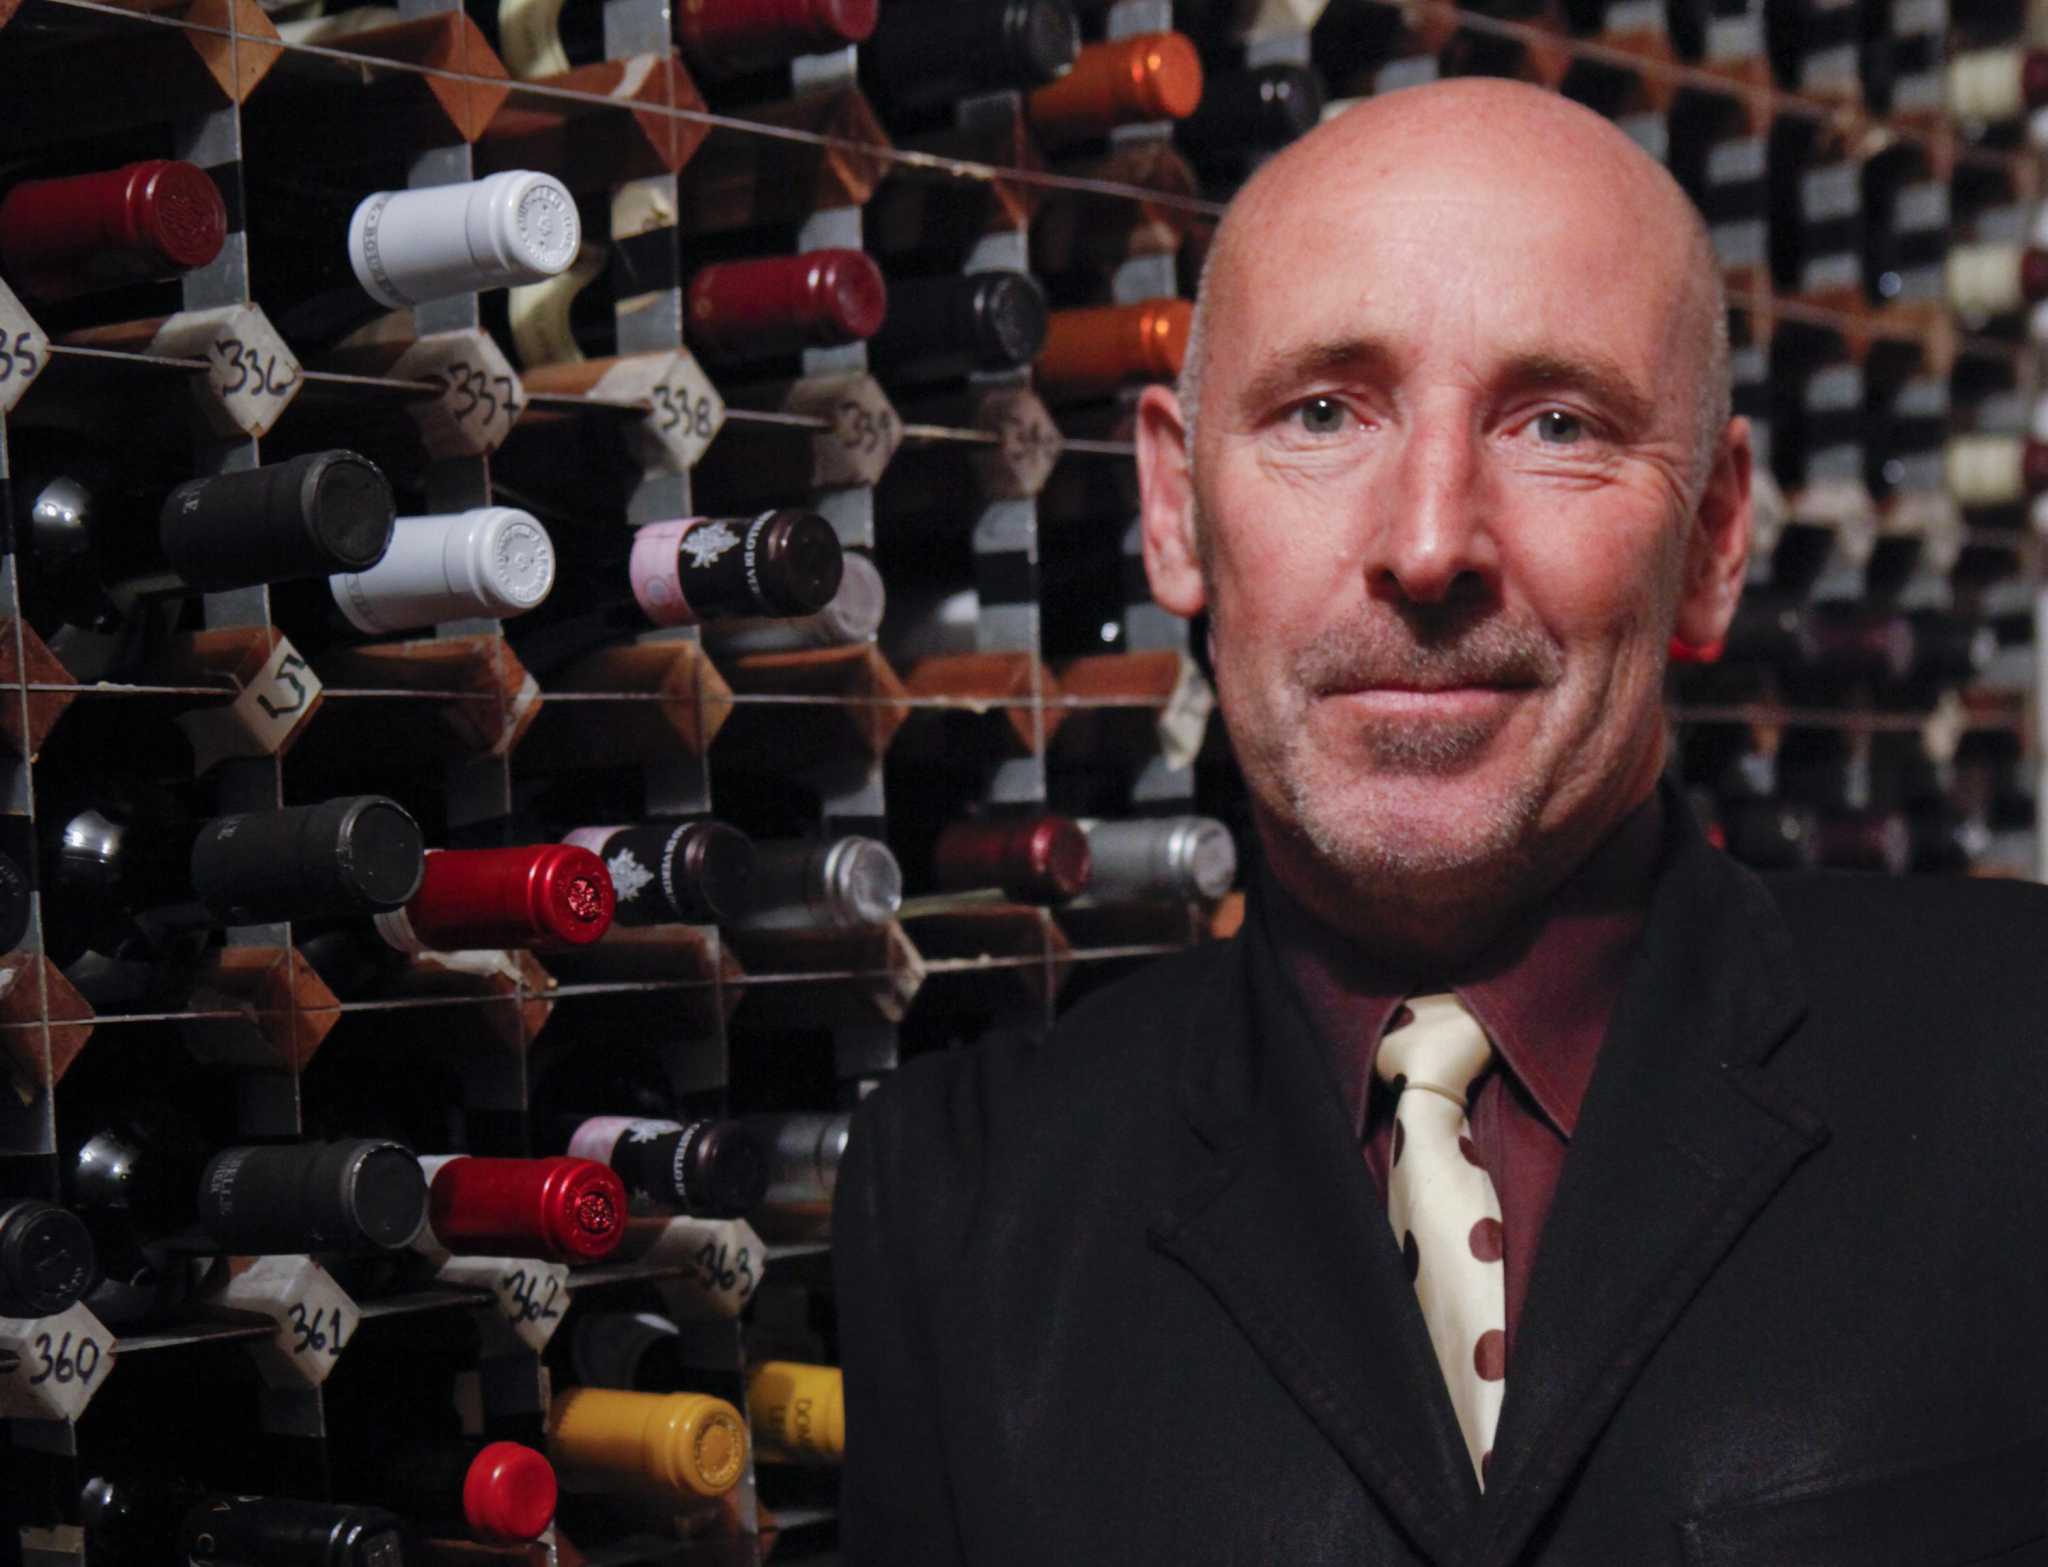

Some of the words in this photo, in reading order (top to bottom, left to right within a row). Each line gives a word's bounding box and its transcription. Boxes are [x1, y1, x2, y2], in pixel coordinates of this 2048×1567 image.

[216, 338, 295, 397] 336
[446, 363, 522, 426] 337
[652, 385, 710, 436] 338
[502, 1269, 560, 1324] 362
[287, 1302, 342, 1355] 361
[29, 1331, 99, 1385] 360
